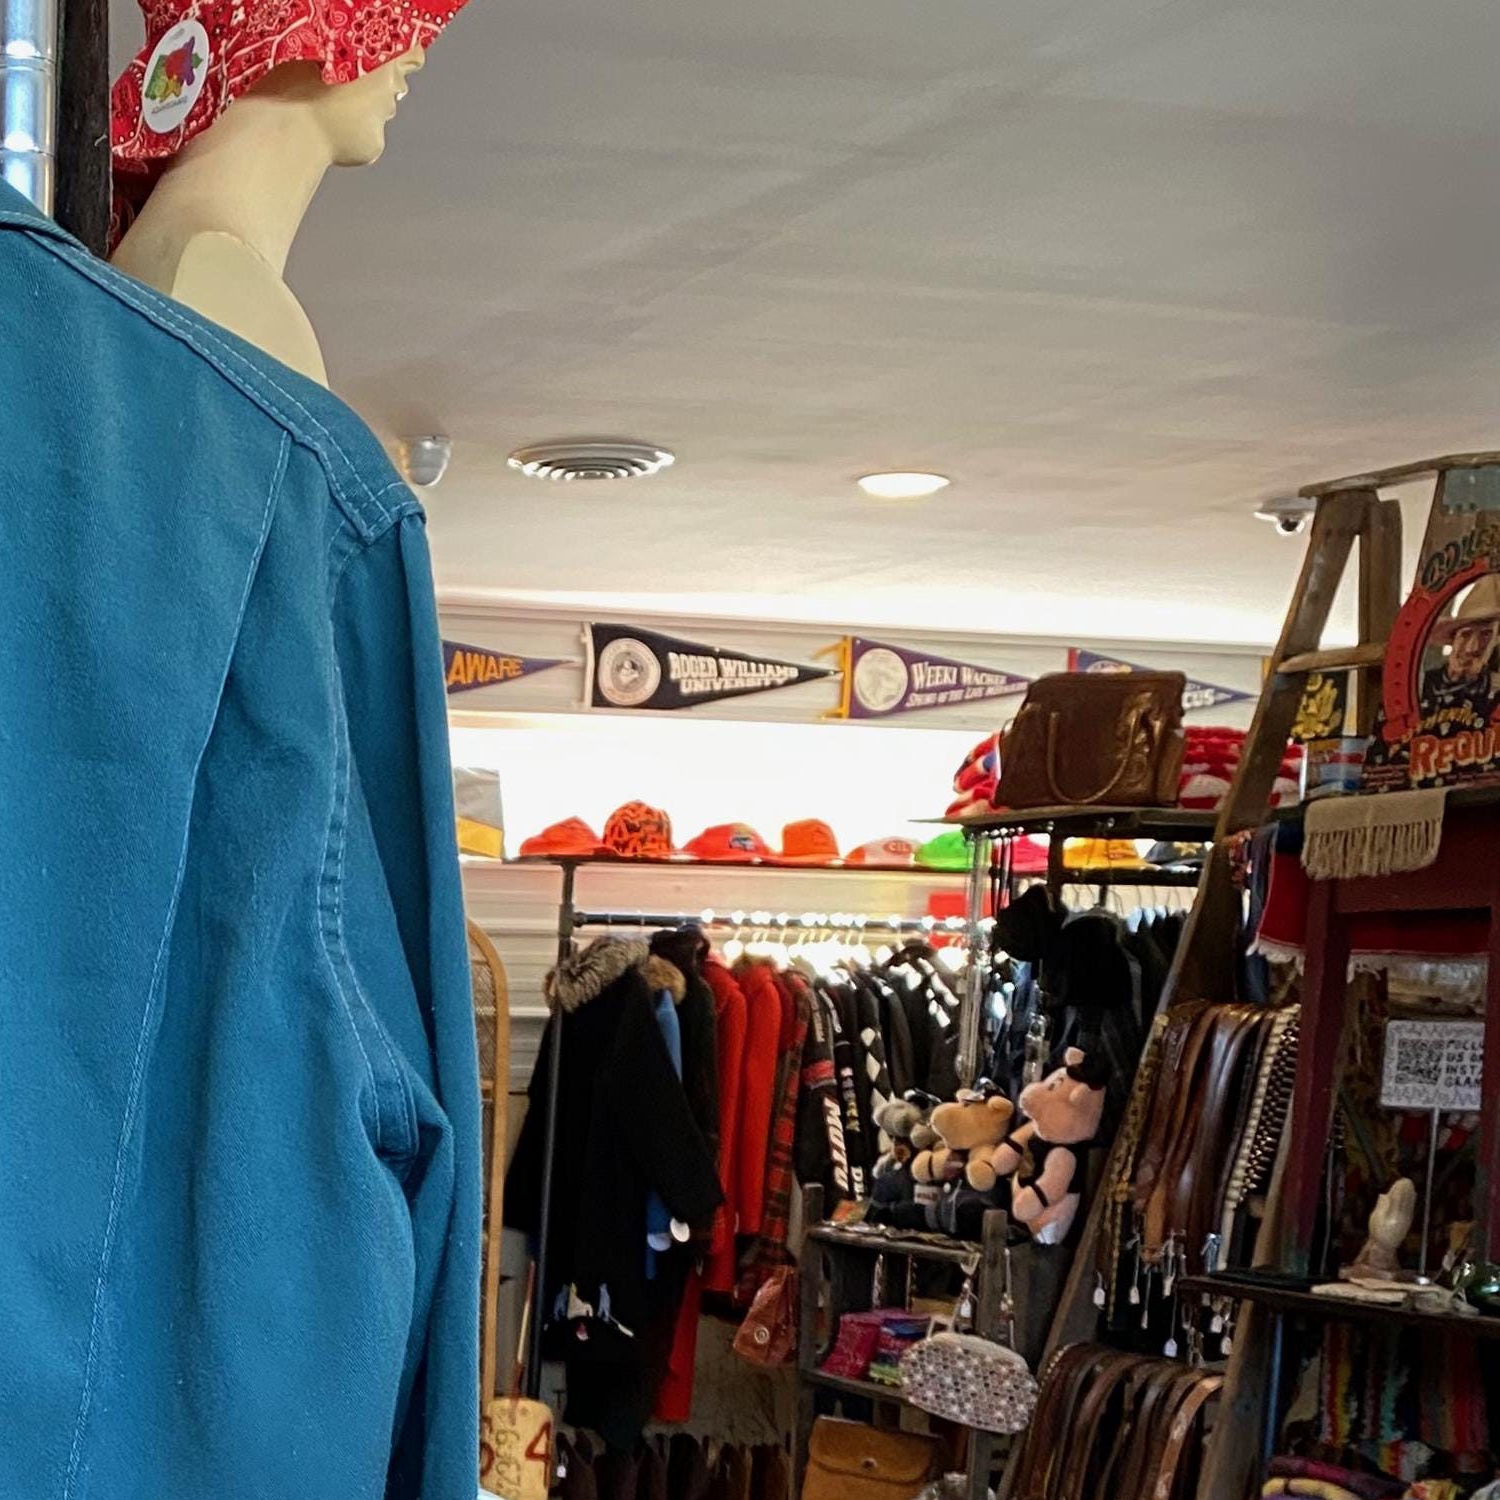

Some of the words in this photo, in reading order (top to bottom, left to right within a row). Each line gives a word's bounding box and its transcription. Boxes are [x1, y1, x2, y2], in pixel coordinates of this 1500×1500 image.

[448, 651, 523, 685] AWARE
[668, 652, 717, 680] ROGER
[718, 658, 799, 679] WILLIAMS
[911, 661, 958, 690] WEEKI
[679, 676, 789, 695] UNIVERSITY
